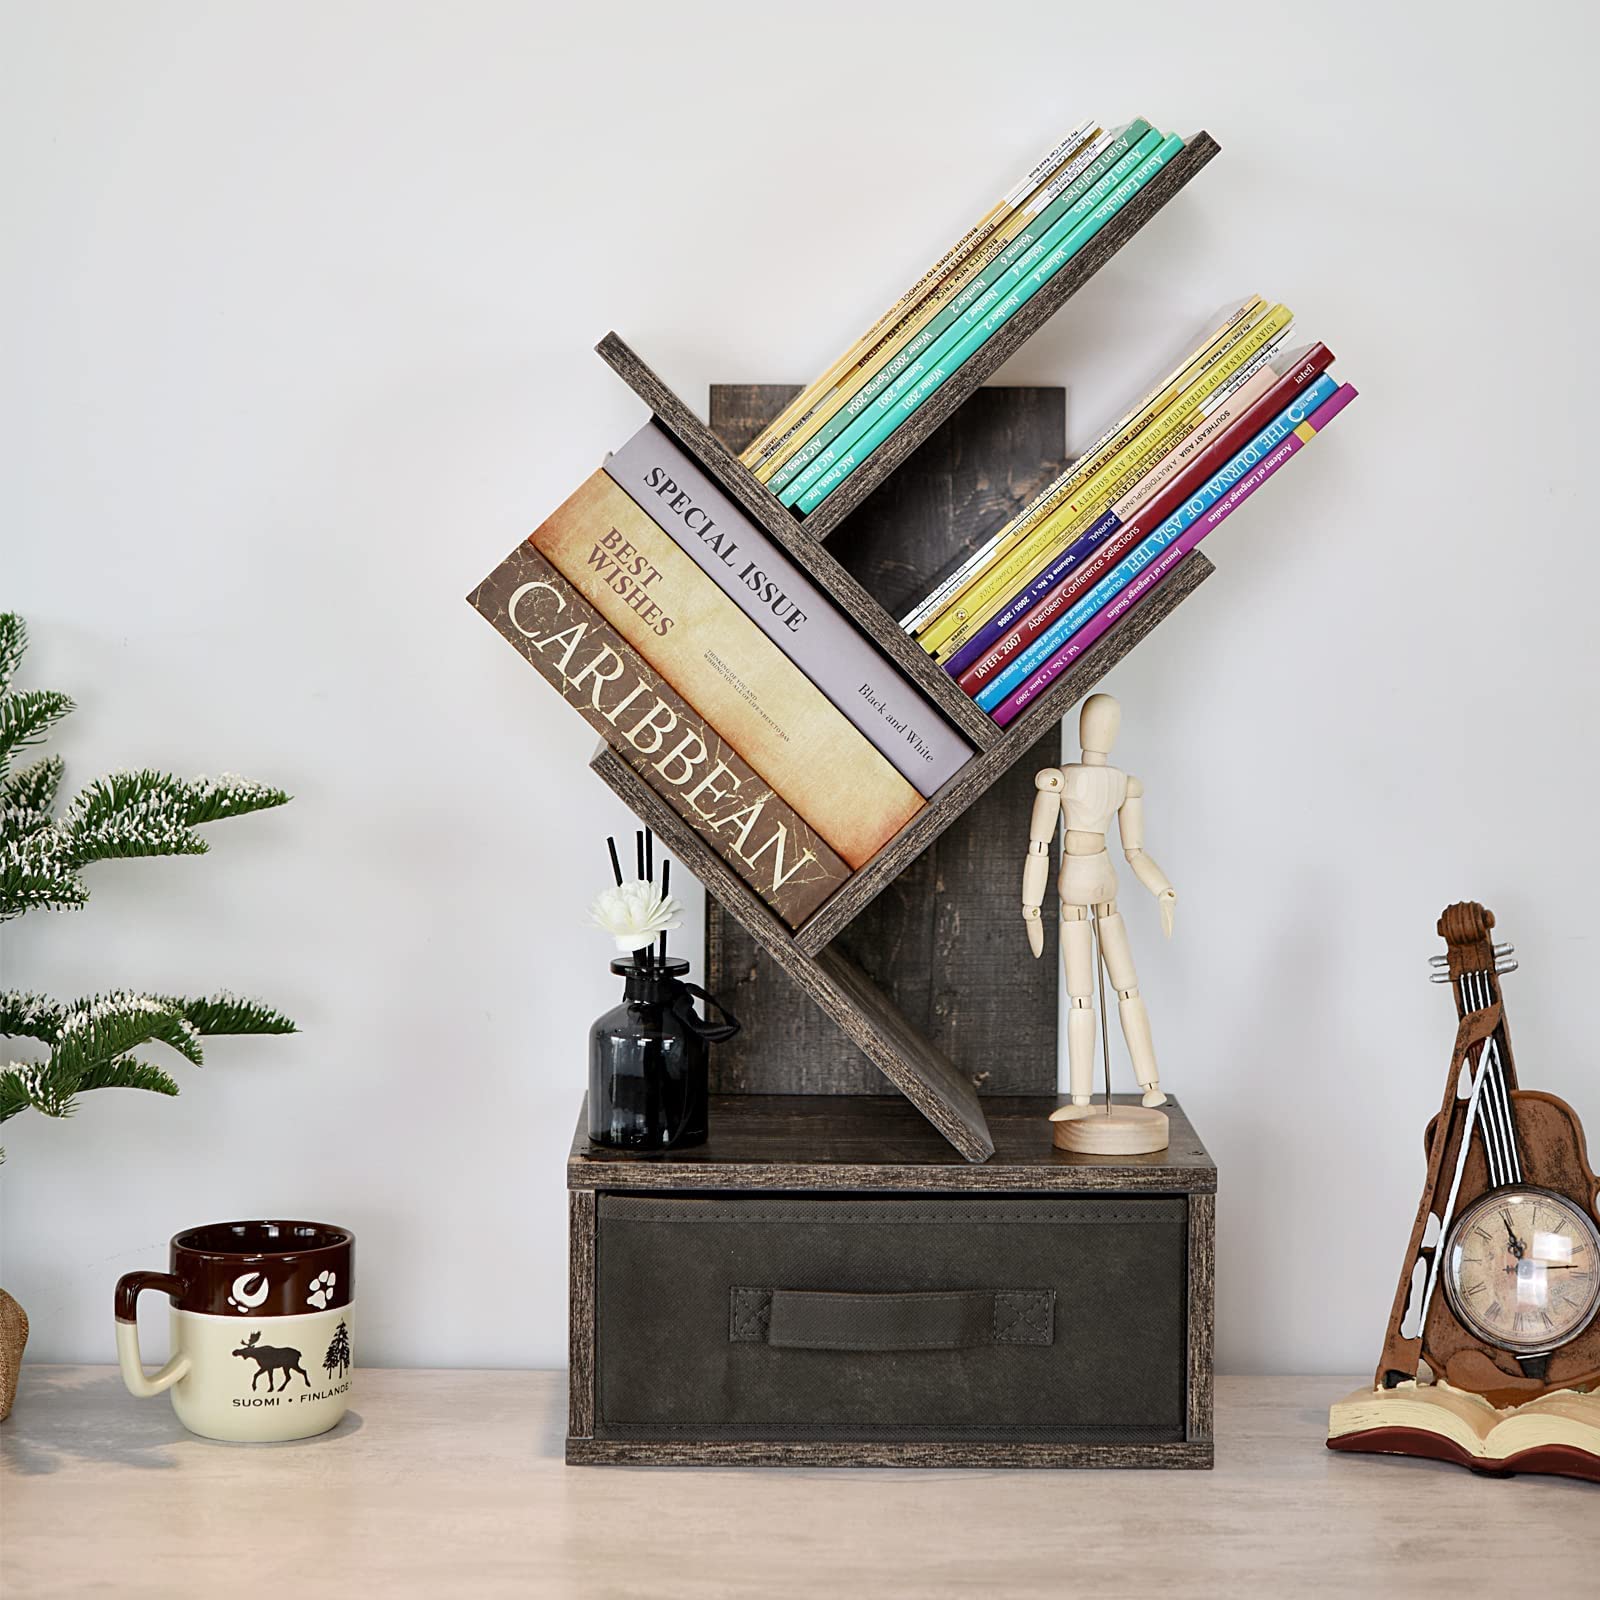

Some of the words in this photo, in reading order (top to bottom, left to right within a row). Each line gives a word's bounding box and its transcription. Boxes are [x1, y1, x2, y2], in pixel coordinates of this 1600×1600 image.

[1102, 137, 1130, 164] Asian
[1114, 148, 1142, 176] Asian
[1135, 153, 1164, 182] Asian
[1060, 160, 1105, 205] Englishes
[1072, 171, 1119, 217] Englishes
[1093, 177, 1140, 223] Englishes
[953, 226, 978, 251] BISCUIT
[970, 223, 995, 248] BISCUIT
[1005, 232, 1033, 259] Volume
[936, 250, 954, 268] GOES
[950, 246, 971, 267] PLAYS
[967, 237, 998, 268] BISCUIT'S
[983, 238, 1008, 263] BISCUIT
[999, 255, 1009, 265] 6
[1017, 243, 1045, 270] Volume
[1035, 247, 1067, 278] Volume
[926, 267, 936, 278] TO
[934, 265, 951, 282] BALL
[952, 266, 969, 283] NEW
[1011, 266, 1021, 276] 4
[1032, 272, 1041, 282] 4
[899, 276, 927, 304] SCHOOL
[934, 281, 954, 301] TRICK
[956, 278, 986, 307] Number
[949, 304, 959, 313] 2
[968, 289, 998, 319] Number
[989, 294, 1019, 324] Number
[983, 321, 991, 329] 2
[1254, 320, 1277, 342] ASIAN
[906, 330, 932, 355] Winter
[1218, 339, 1256, 376] JOURNAL
[863, 351, 909, 397] 2003/Spring
[893, 361, 924, 391] Summer
[917, 366, 944, 393] Winter
[1207, 374, 1219, 386] OF
[1292, 363, 1315, 384] iatefl
[846, 393, 868, 415] 2004
[876, 388, 896, 409] 2001
[900, 389, 921, 410] 2001
[1159, 383, 1208, 430] LITERATURE,
[1129, 412, 1154, 436] BISCUIT
[1168, 423, 1194, 448] BISCUIT
[1193, 409, 1230, 445] SOUTHEAST
[1258, 420, 1288, 449] THE
[805, 437, 822, 455] ALC
[1114, 435, 1130, 450] AND
[1124, 427, 1161, 462] CULTURE
[1178, 442, 1195, 458] ASIA
[784, 450, 808, 474] Press,
[818, 450, 835, 466] ALC
[838, 454, 856, 472] ALC
[1100, 449, 1114, 463] THE
[1148, 446, 1169, 466] MEETS
[1263, 443, 1292, 470] Academy
[772, 470, 789, 487] Inc.
[797, 462, 821, 486] Press,
[818, 467, 841, 490] Press,
[1083, 461, 1101, 478] BABY
[1108, 460, 1127, 478] AND
[1135, 464, 1150, 478] THE
[1202, 445, 1261, 502] JOURNAL
[1256, 468, 1266, 478] of
[785, 483, 801, 498] Inc.
[805, 487, 822, 503] Inc.
[1076, 475, 1109, 507] SOCIETY
[1114, 477, 1136, 498] CLASS
[1115, 462, 1173, 518] MULTIDISCIPLINARY
[1228, 474, 1258, 503] Language
[1012, 512, 1037, 536] BISCUIT
[1037, 493, 1058, 513] TAKES
[1063, 469, 1083, 489] WALK
[1103, 496, 1116, 509] PET
[1182, 497, 1206, 519] OF
[1206, 499, 1232, 524] Studies
[1087, 514, 1118, 543] JOURNAL
[1151, 515, 1185, 547] ASIA
[598, 526, 664, 592] BEST
[641, 464, 745, 569] SPECIAL
[736, 560, 809, 633] ISSUE
[1121, 543, 1155, 576] TEFL
[1158, 547, 1182, 569] Journal
[1045, 572, 1054, 581] 6,
[1052, 553, 1075, 576] Volume
[1152, 566, 1162, 576] of
[582, 544, 676, 638] WISHES
[1035, 579, 1047, 591] No.
[1101, 576, 1125, 600] VOLUME
[1125, 572, 1155, 600] Language
[973, 651, 1003, 679] IATEFL
[1000, 633, 1022, 654] 2007
[1025, 594, 1062, 630] Aberdeen
[1060, 557, 1104, 598] Conference
[1101, 524, 1140, 561] Selections
[1013, 595, 1030, 612] 2005
[1105, 597, 1129, 619] Studies
[996, 611, 1013, 627] 2006
[1068, 605, 1094, 631] NUMBER
[1035, 636, 1061, 660] SUMMER
[1066, 643, 1079, 656] Vol.
[702, 653, 724, 675] WISHING
[722, 673, 734, 686] YOU
[732, 684, 743, 695] ALL
[741, 692, 749, 700] OF
[706, 649, 731, 674] THINKING
[728, 672, 736, 680] OF
[735, 679, 747, 691] YOU
[745, 689, 757, 701] AND
[1021, 658, 1037, 674] 2006
[1050, 658, 1063, 671] No.
[1028, 676, 1044, 692] June
[1014, 689, 1031, 705] 2009
[856, 682, 890, 715] Black
[882, 709, 909, 735] and
[902, 729, 938, 765] White
[502, 577, 817, 895] CARIBBEAN
[232, 1398, 280, 1407] SUOMI
